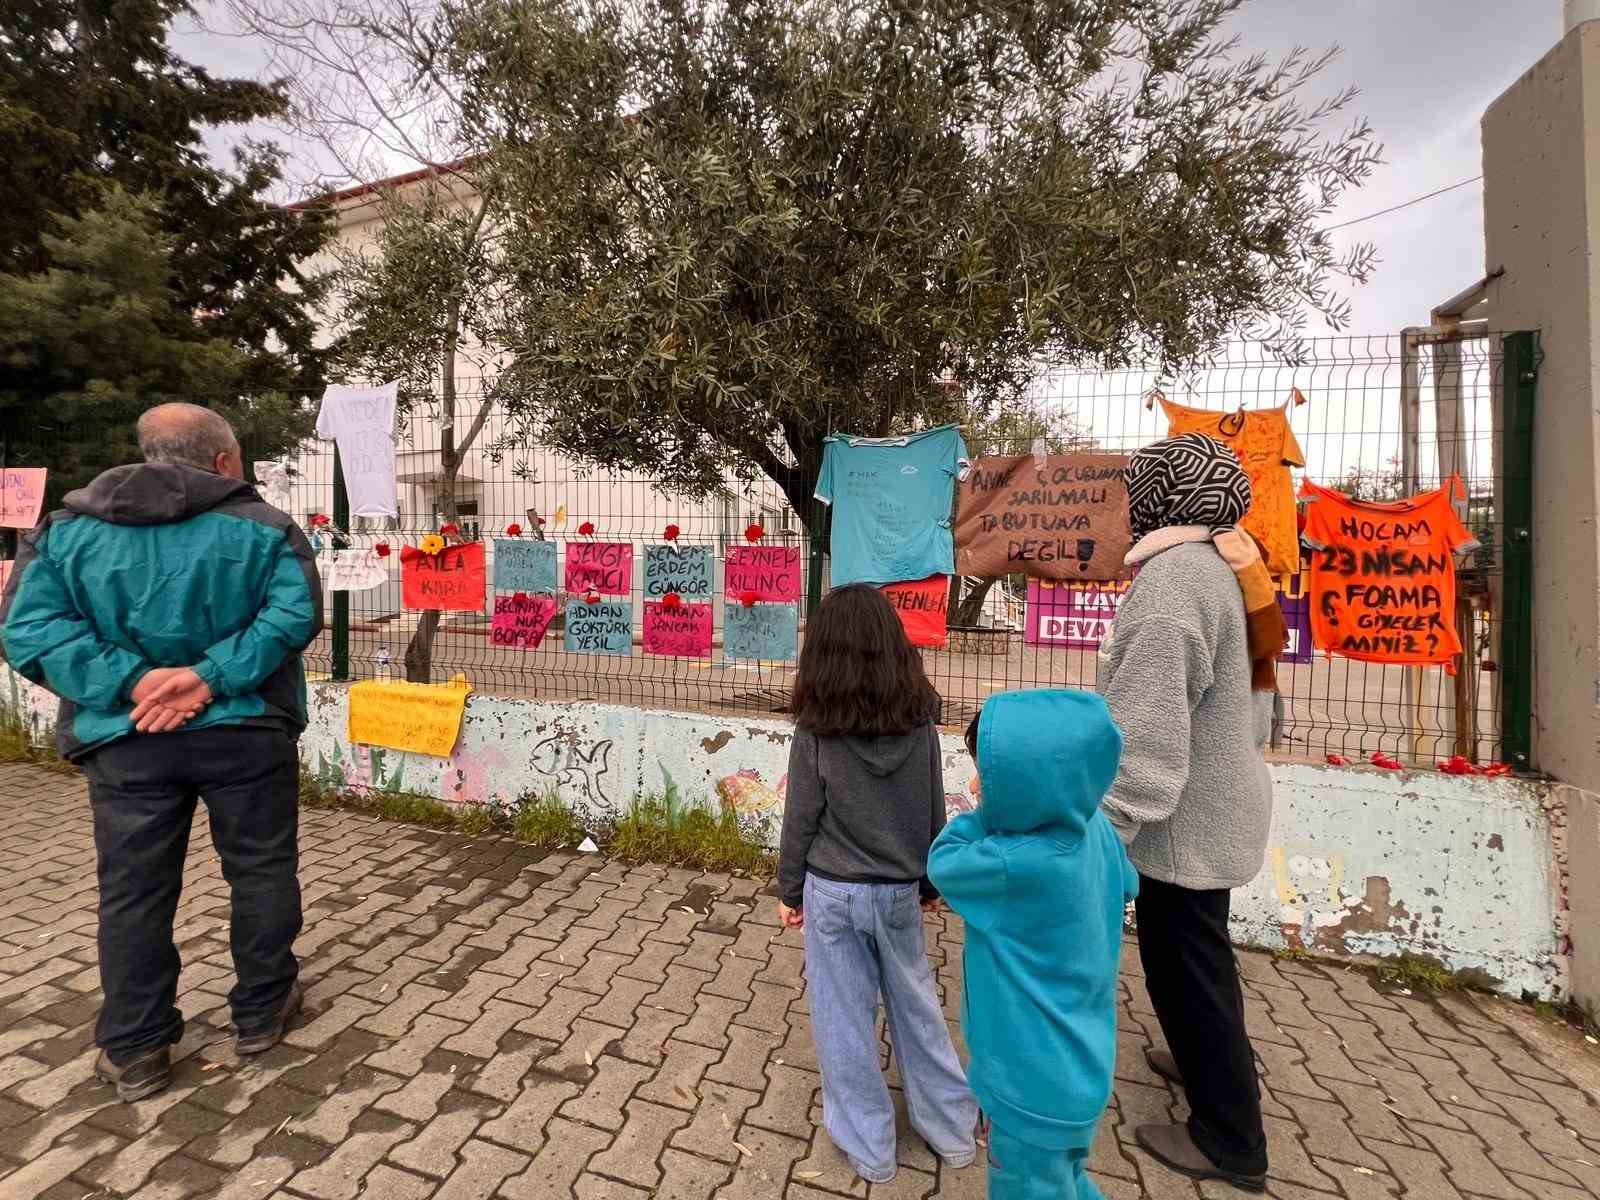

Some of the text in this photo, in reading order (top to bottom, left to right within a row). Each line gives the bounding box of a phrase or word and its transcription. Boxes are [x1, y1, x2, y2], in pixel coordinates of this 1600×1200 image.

[1341, 516, 1432, 541] HOCAM
[727, 549, 797, 569] ZEYNEP
[1319, 546, 1358, 577] 23
[646, 561, 706, 578] ERDEM
[648, 577, 709, 595] GÜNGÖR
[569, 606, 623, 618] ADNAN
[515, 615, 545, 628] NUR
[494, 627, 542, 645] BOYRA
